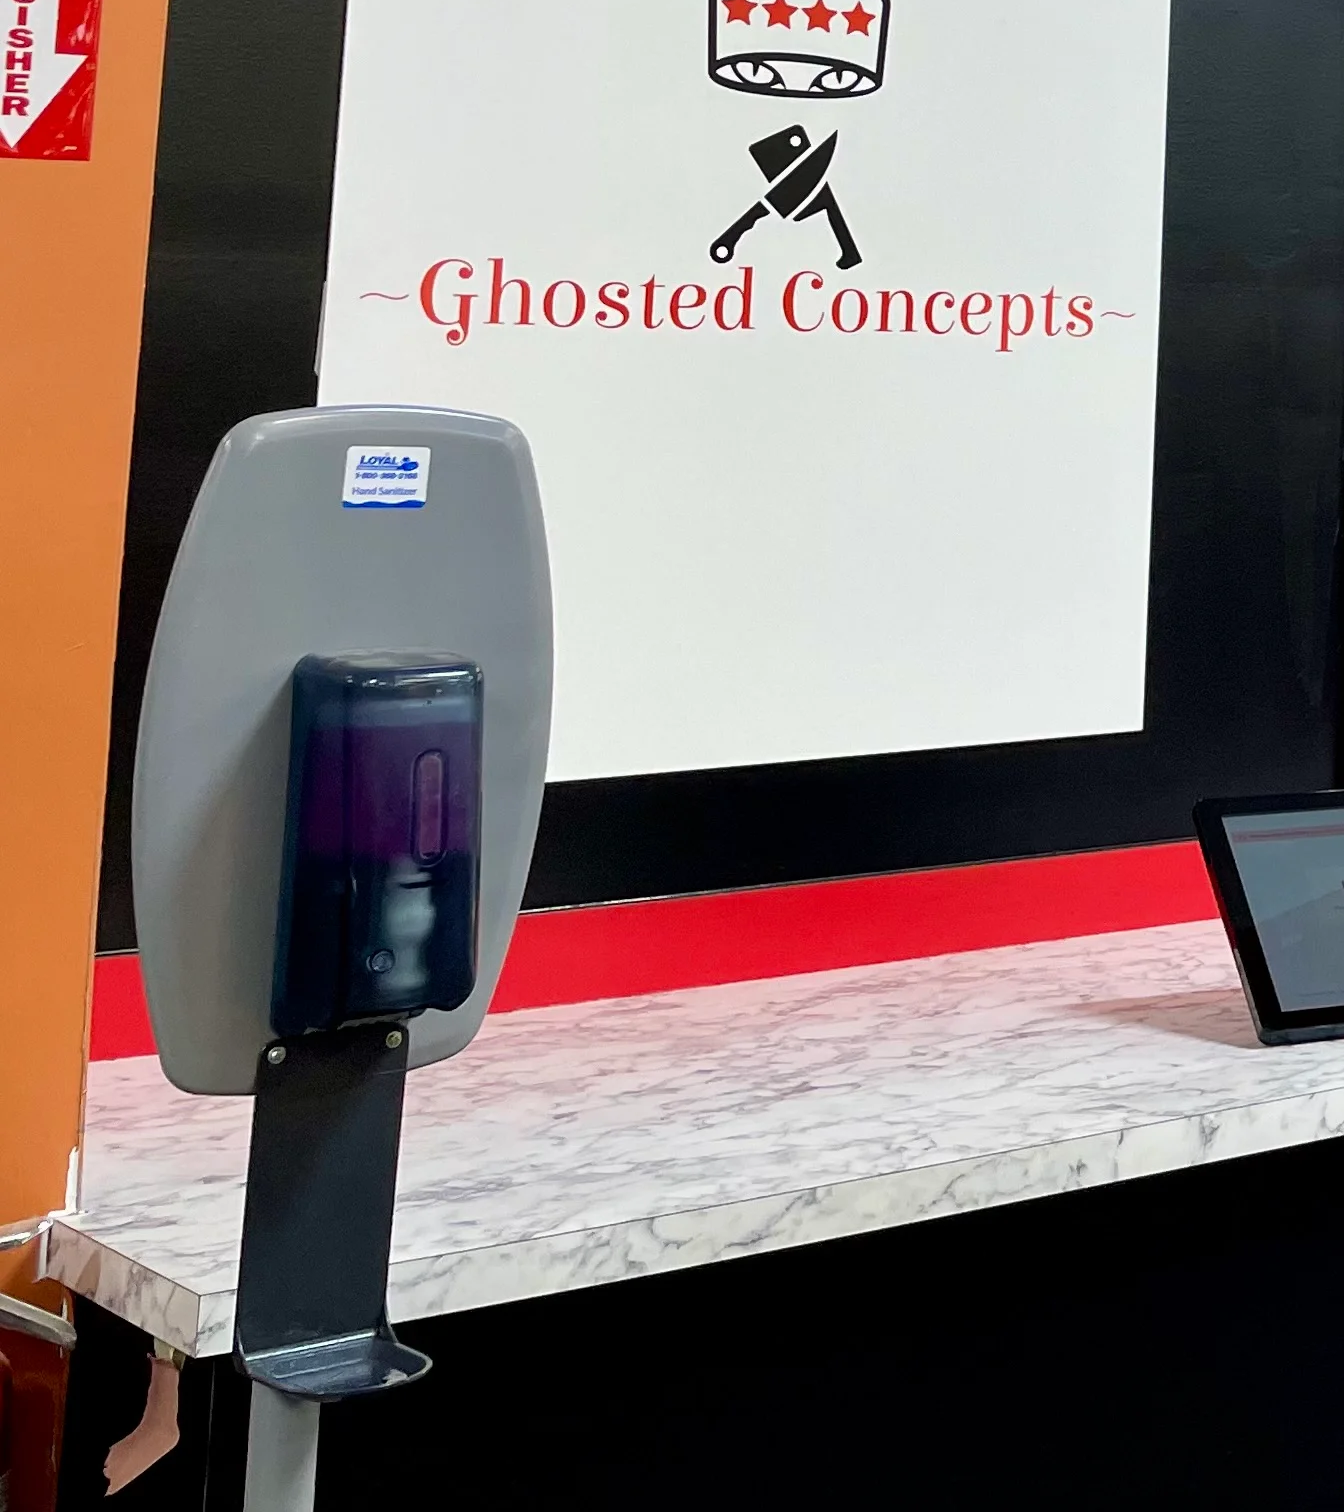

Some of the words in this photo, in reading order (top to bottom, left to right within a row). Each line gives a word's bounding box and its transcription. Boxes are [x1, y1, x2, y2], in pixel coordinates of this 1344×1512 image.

[360, 454, 399, 465] LOYAL
[351, 486, 377, 496] Hand
[377, 486, 418, 496] Sanitizer
